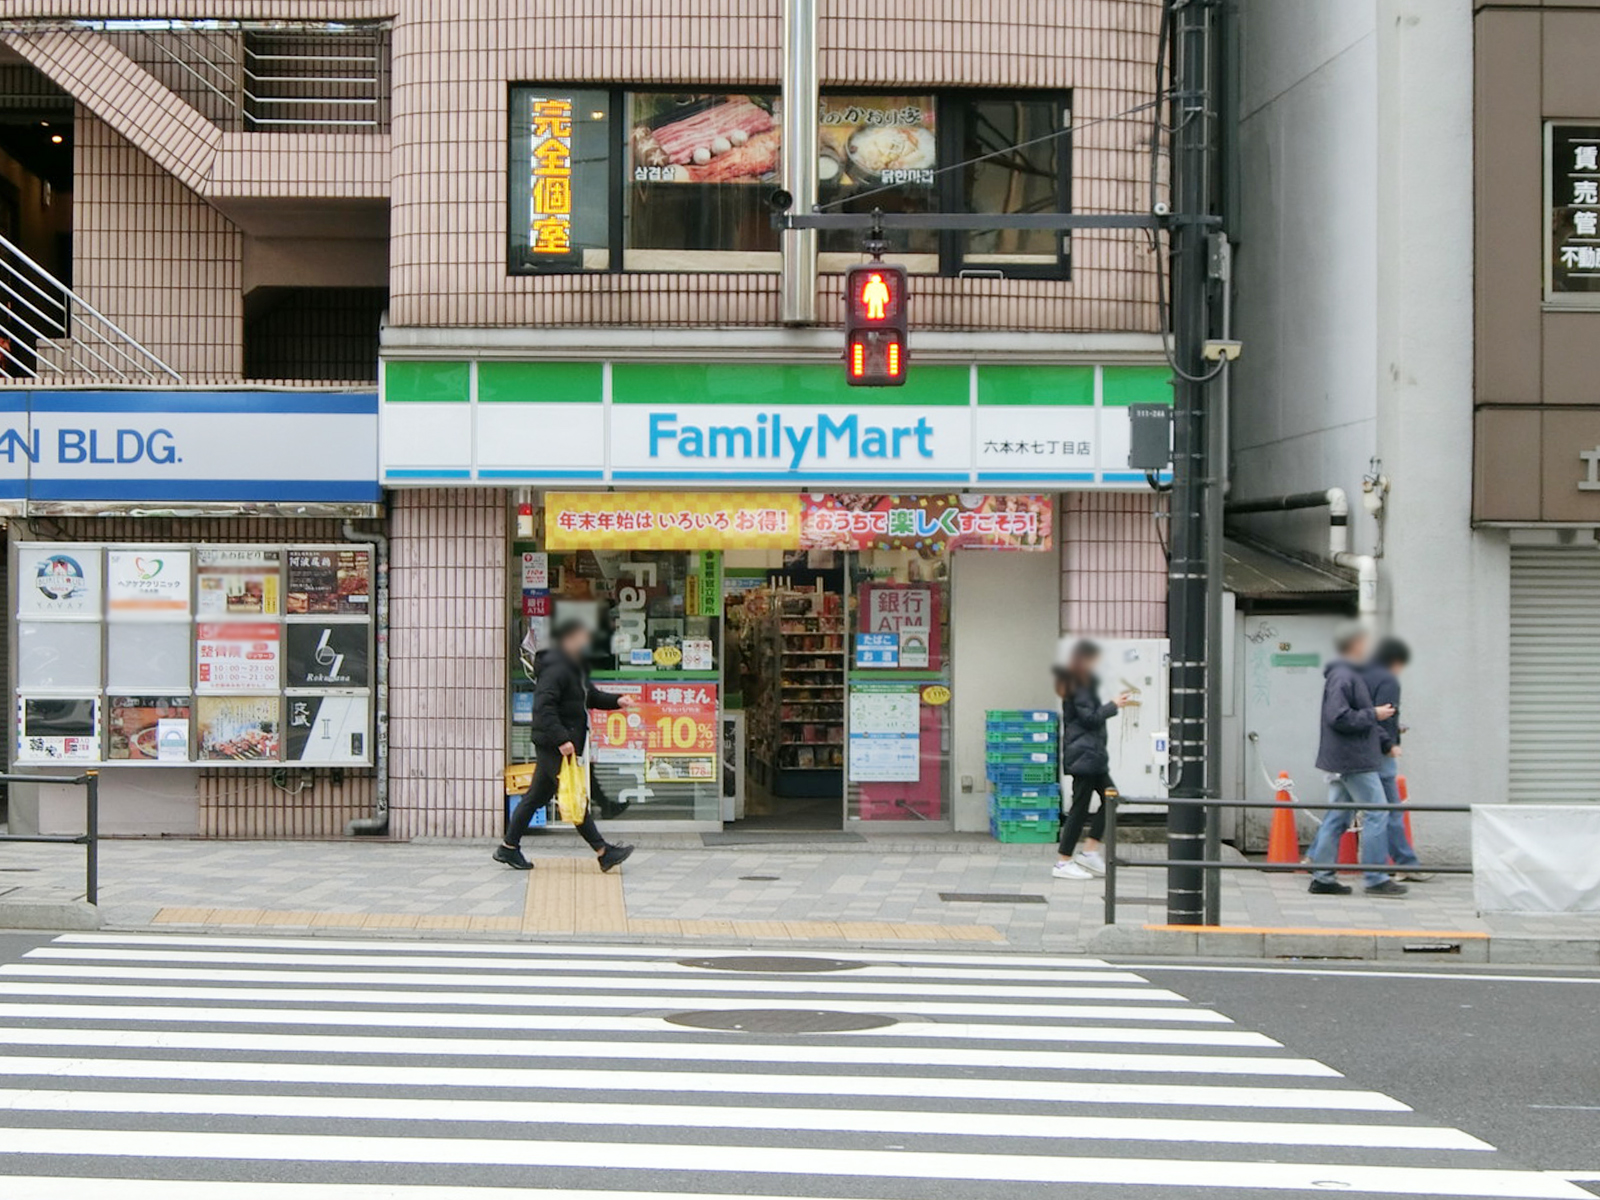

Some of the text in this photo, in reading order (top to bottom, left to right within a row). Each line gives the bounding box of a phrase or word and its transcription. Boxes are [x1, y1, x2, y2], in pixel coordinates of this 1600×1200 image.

[819, 104, 923, 126] のかおり家
[533, 99, 572, 254] 完全個室
[634, 166, 676, 181] 삼겹살
[1561, 246, 1600, 268] 不動
[58, 428, 183, 465] BLDG.
[649, 412, 934, 474] FamilyMart
[983, 440, 1092, 456] 六本木七丁目店
[558, 510, 788, 532] 年末年始は いろいろ お得!
[814, 508, 1037, 536] おうちで楽しくすごそう!
[878, 591, 924, 613] 銀行
[863, 635, 892, 645] たばこ
[651, 688, 711, 705] 中華まん
